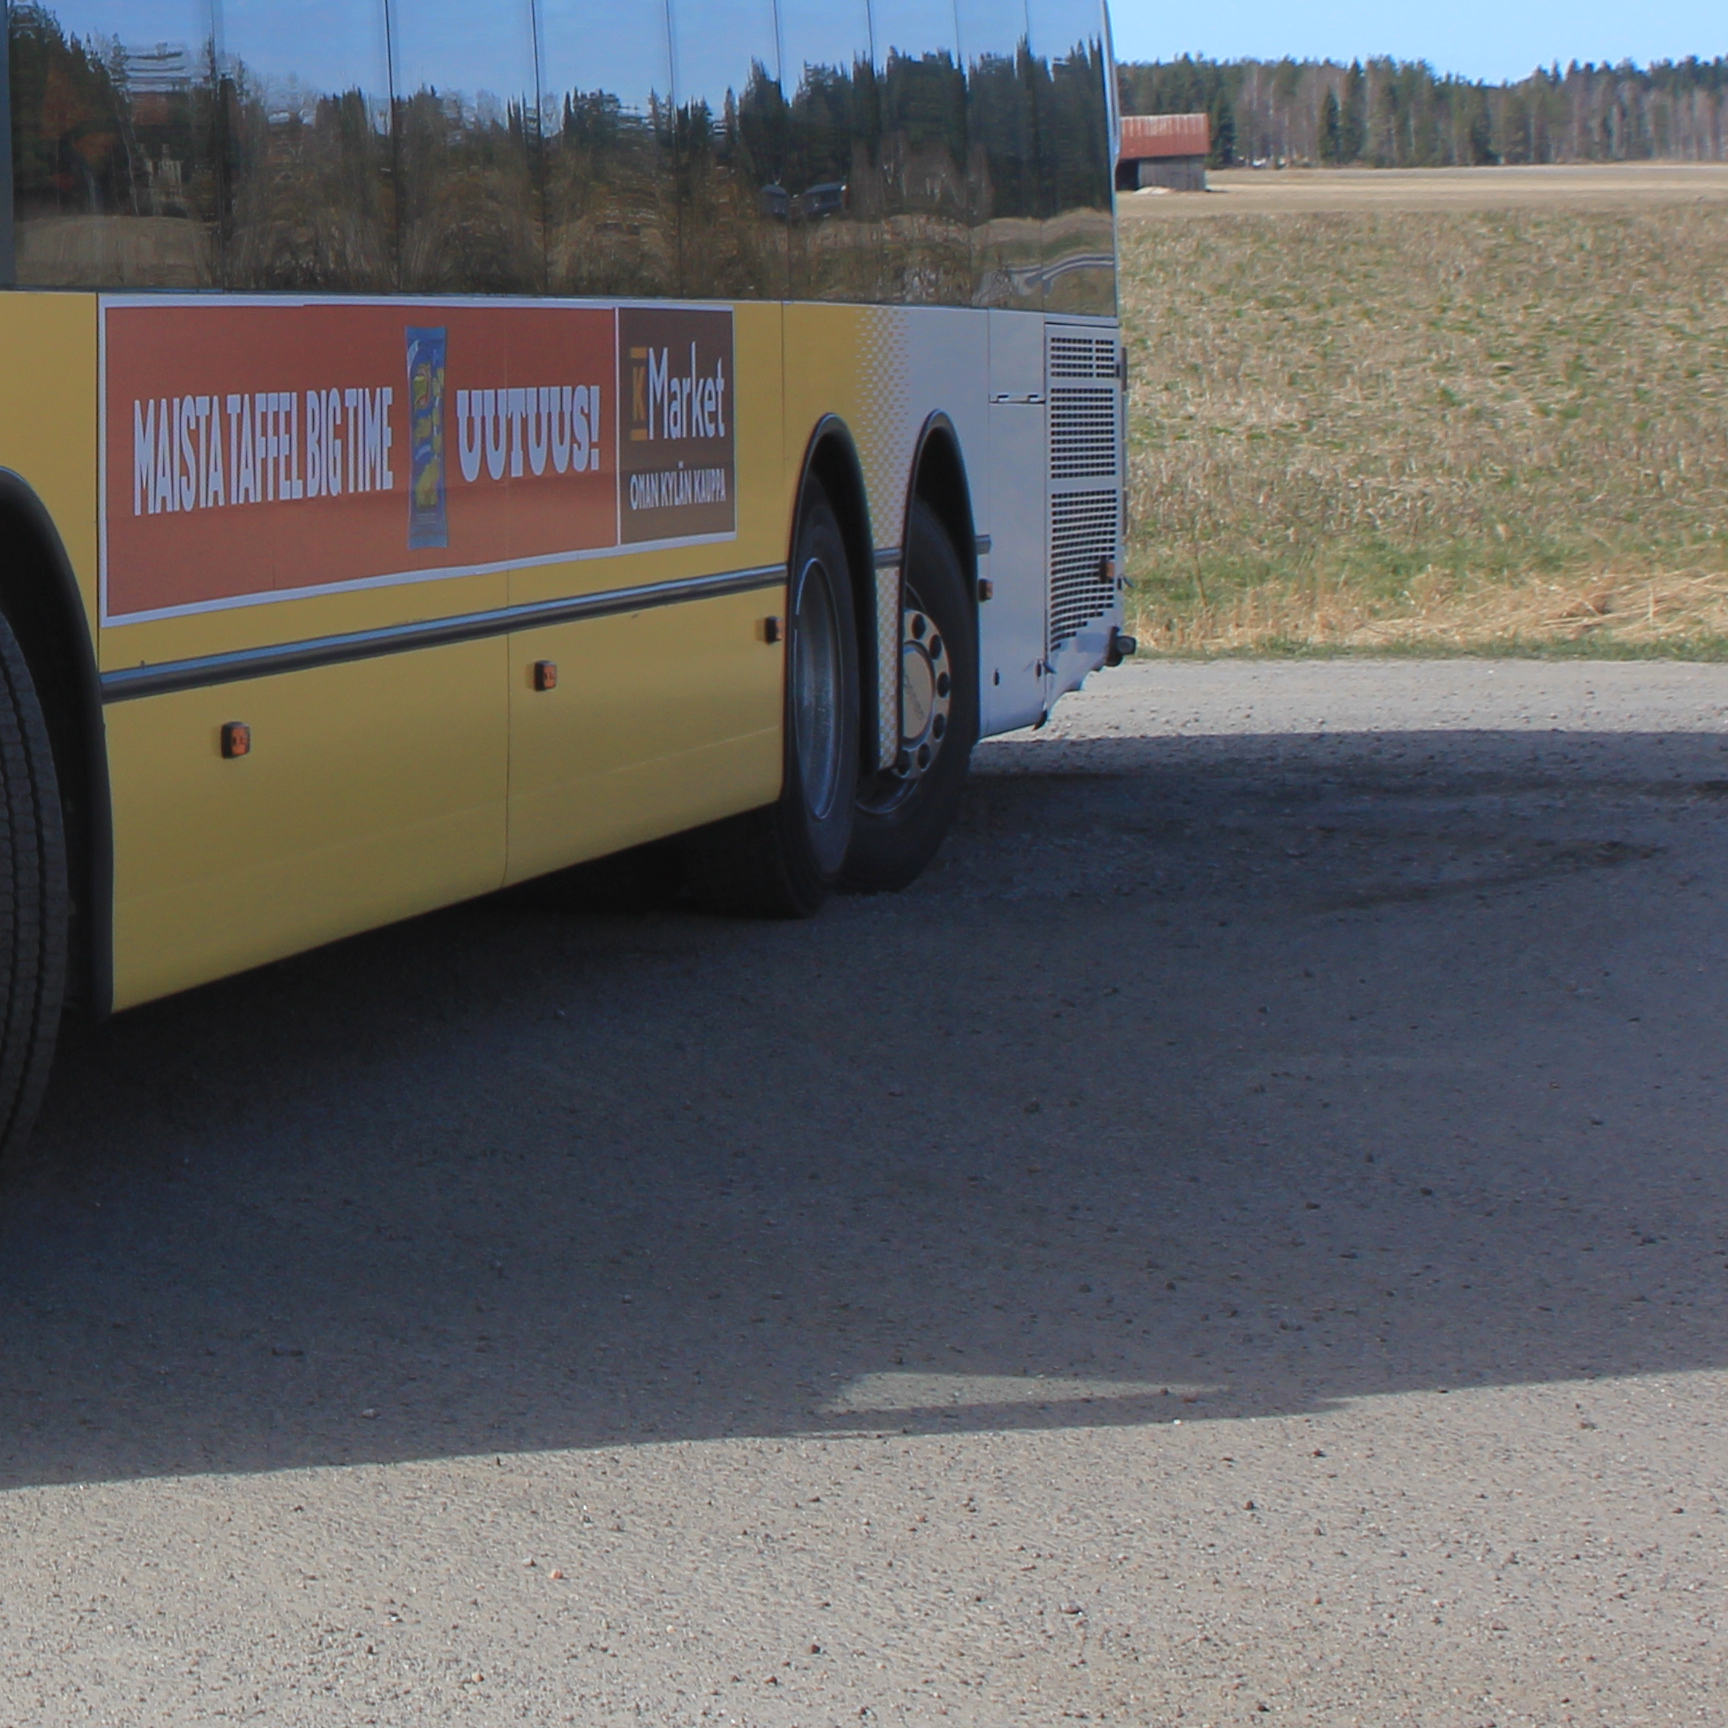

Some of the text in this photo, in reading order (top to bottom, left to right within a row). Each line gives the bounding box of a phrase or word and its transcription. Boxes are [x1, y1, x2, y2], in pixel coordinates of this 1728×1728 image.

[456, 384, 600, 483] UUTUUS!
[648, 341, 725, 440] Market
[134, 387, 393, 516] MAISTA TAFFEL BIG TIME
[630, 461, 726, 510] OMAN KYLÄN KAUPPA
